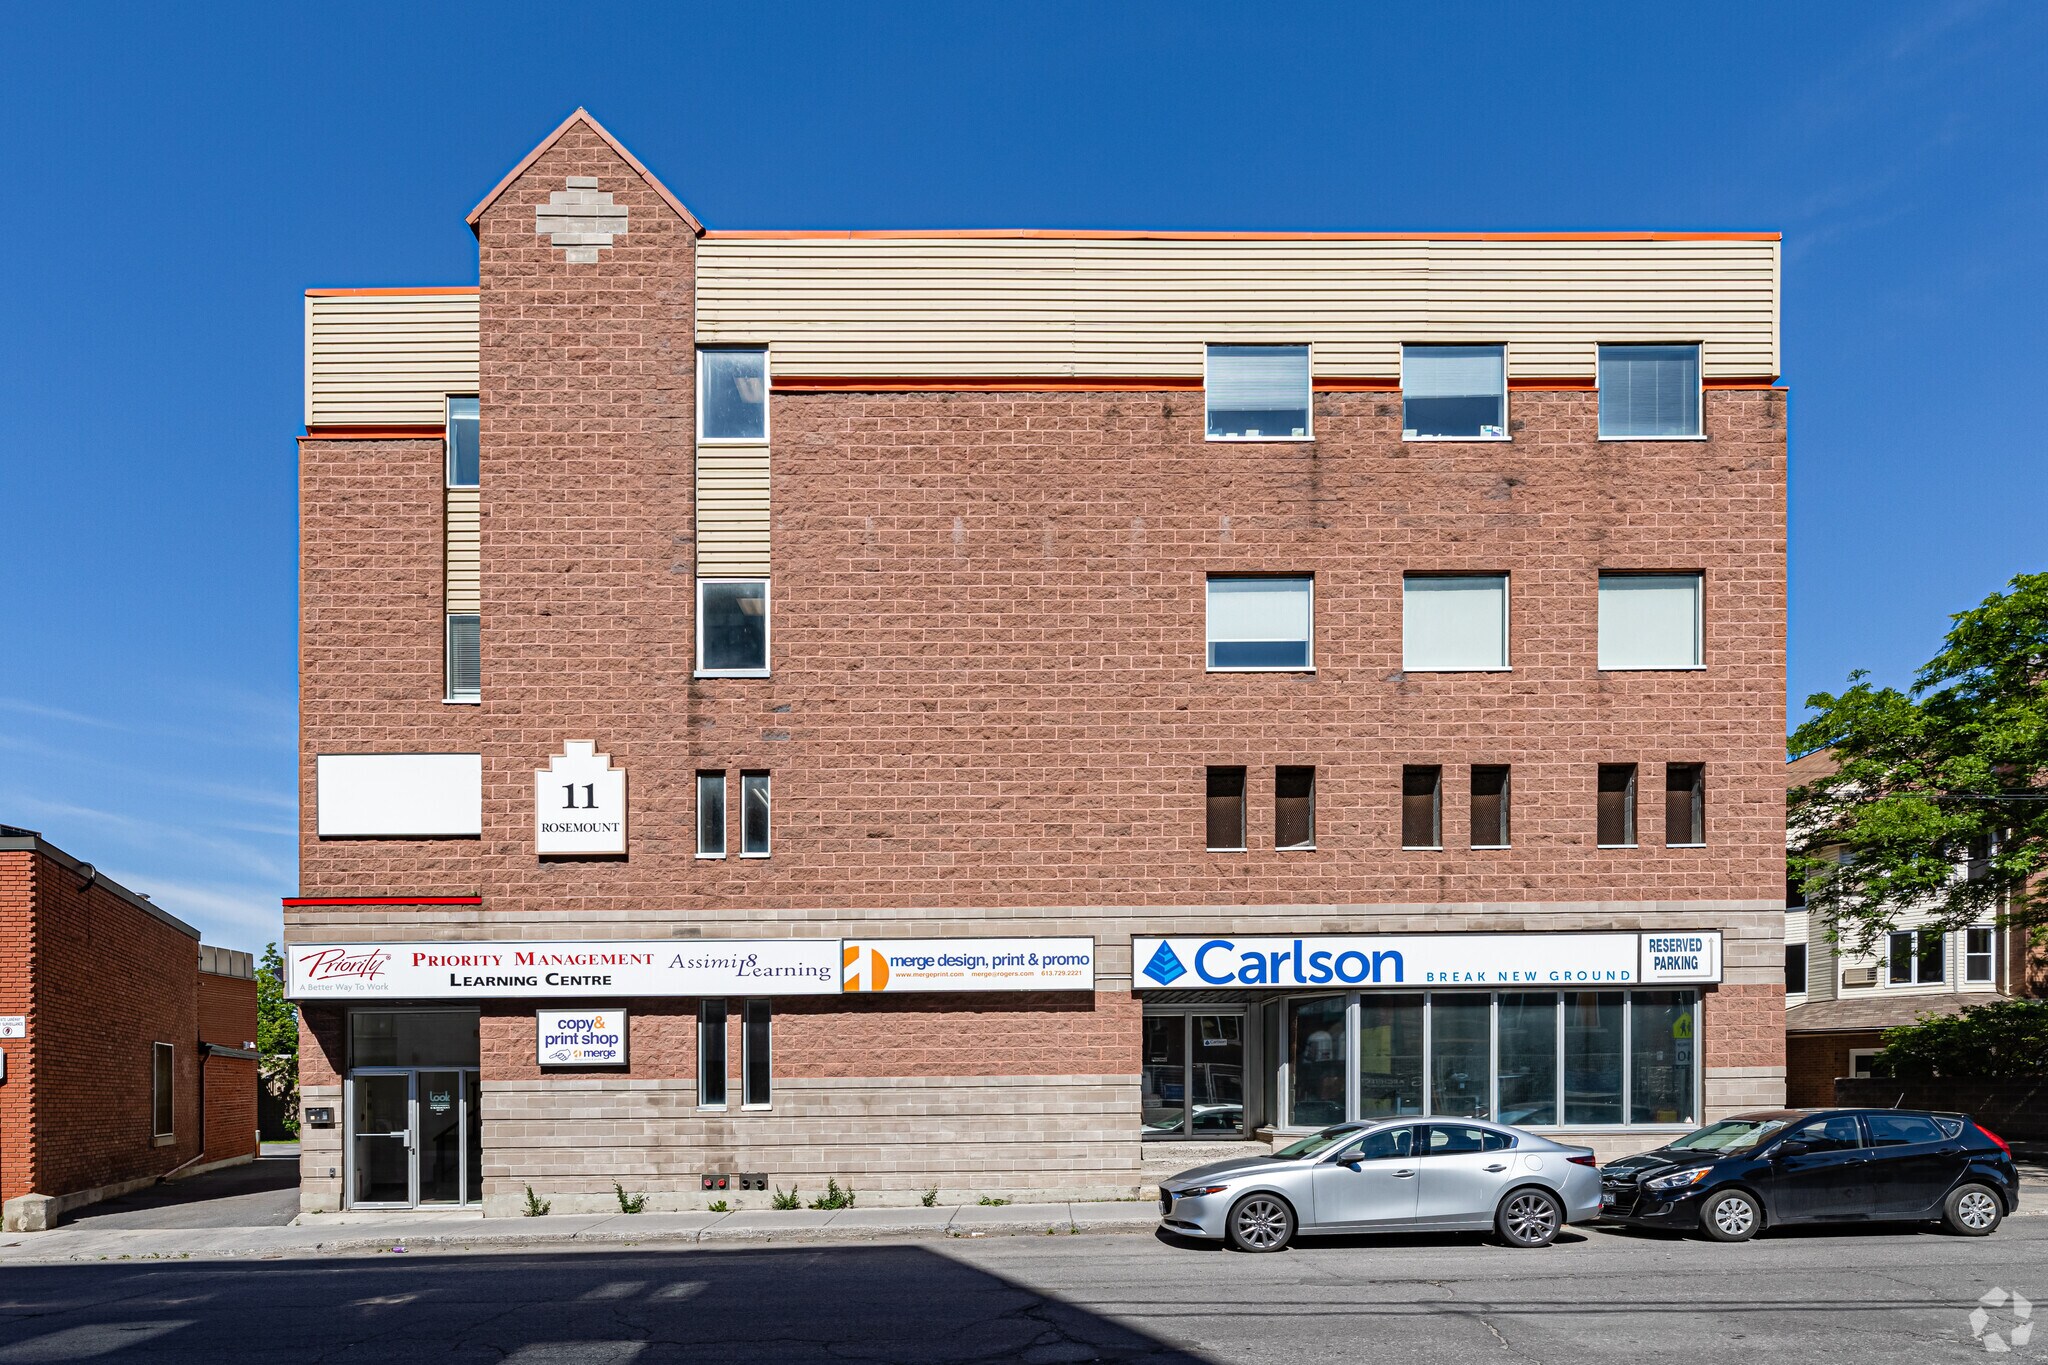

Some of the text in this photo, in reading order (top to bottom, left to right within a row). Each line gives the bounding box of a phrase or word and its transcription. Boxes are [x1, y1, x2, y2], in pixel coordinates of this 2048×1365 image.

[562, 783, 599, 809] 11
[541, 822, 620, 833] ROSEMOUNT
[1649, 938, 1703, 953] RESERVED
[412, 951, 655, 967] PRIORITY MANAGEMENT
[890, 952, 1090, 970] merge design, print & promo
[1195, 939, 1404, 985] Carlson
[1653, 955, 1699, 970] PARKING
[735, 959, 832, 982] Learning
[895, 969, 1083, 979] www.mergeprint.com merge@rogers.com 613.729.2221
[1426, 970, 1631, 982] BREAK NEW GROUND
[299, 982, 389, 992] A Better Way To Work
[449, 973, 612, 987] LEARNING CENTRE
[545, 1032, 619, 1048] print shop
[583, 1049, 617, 1060] merge
